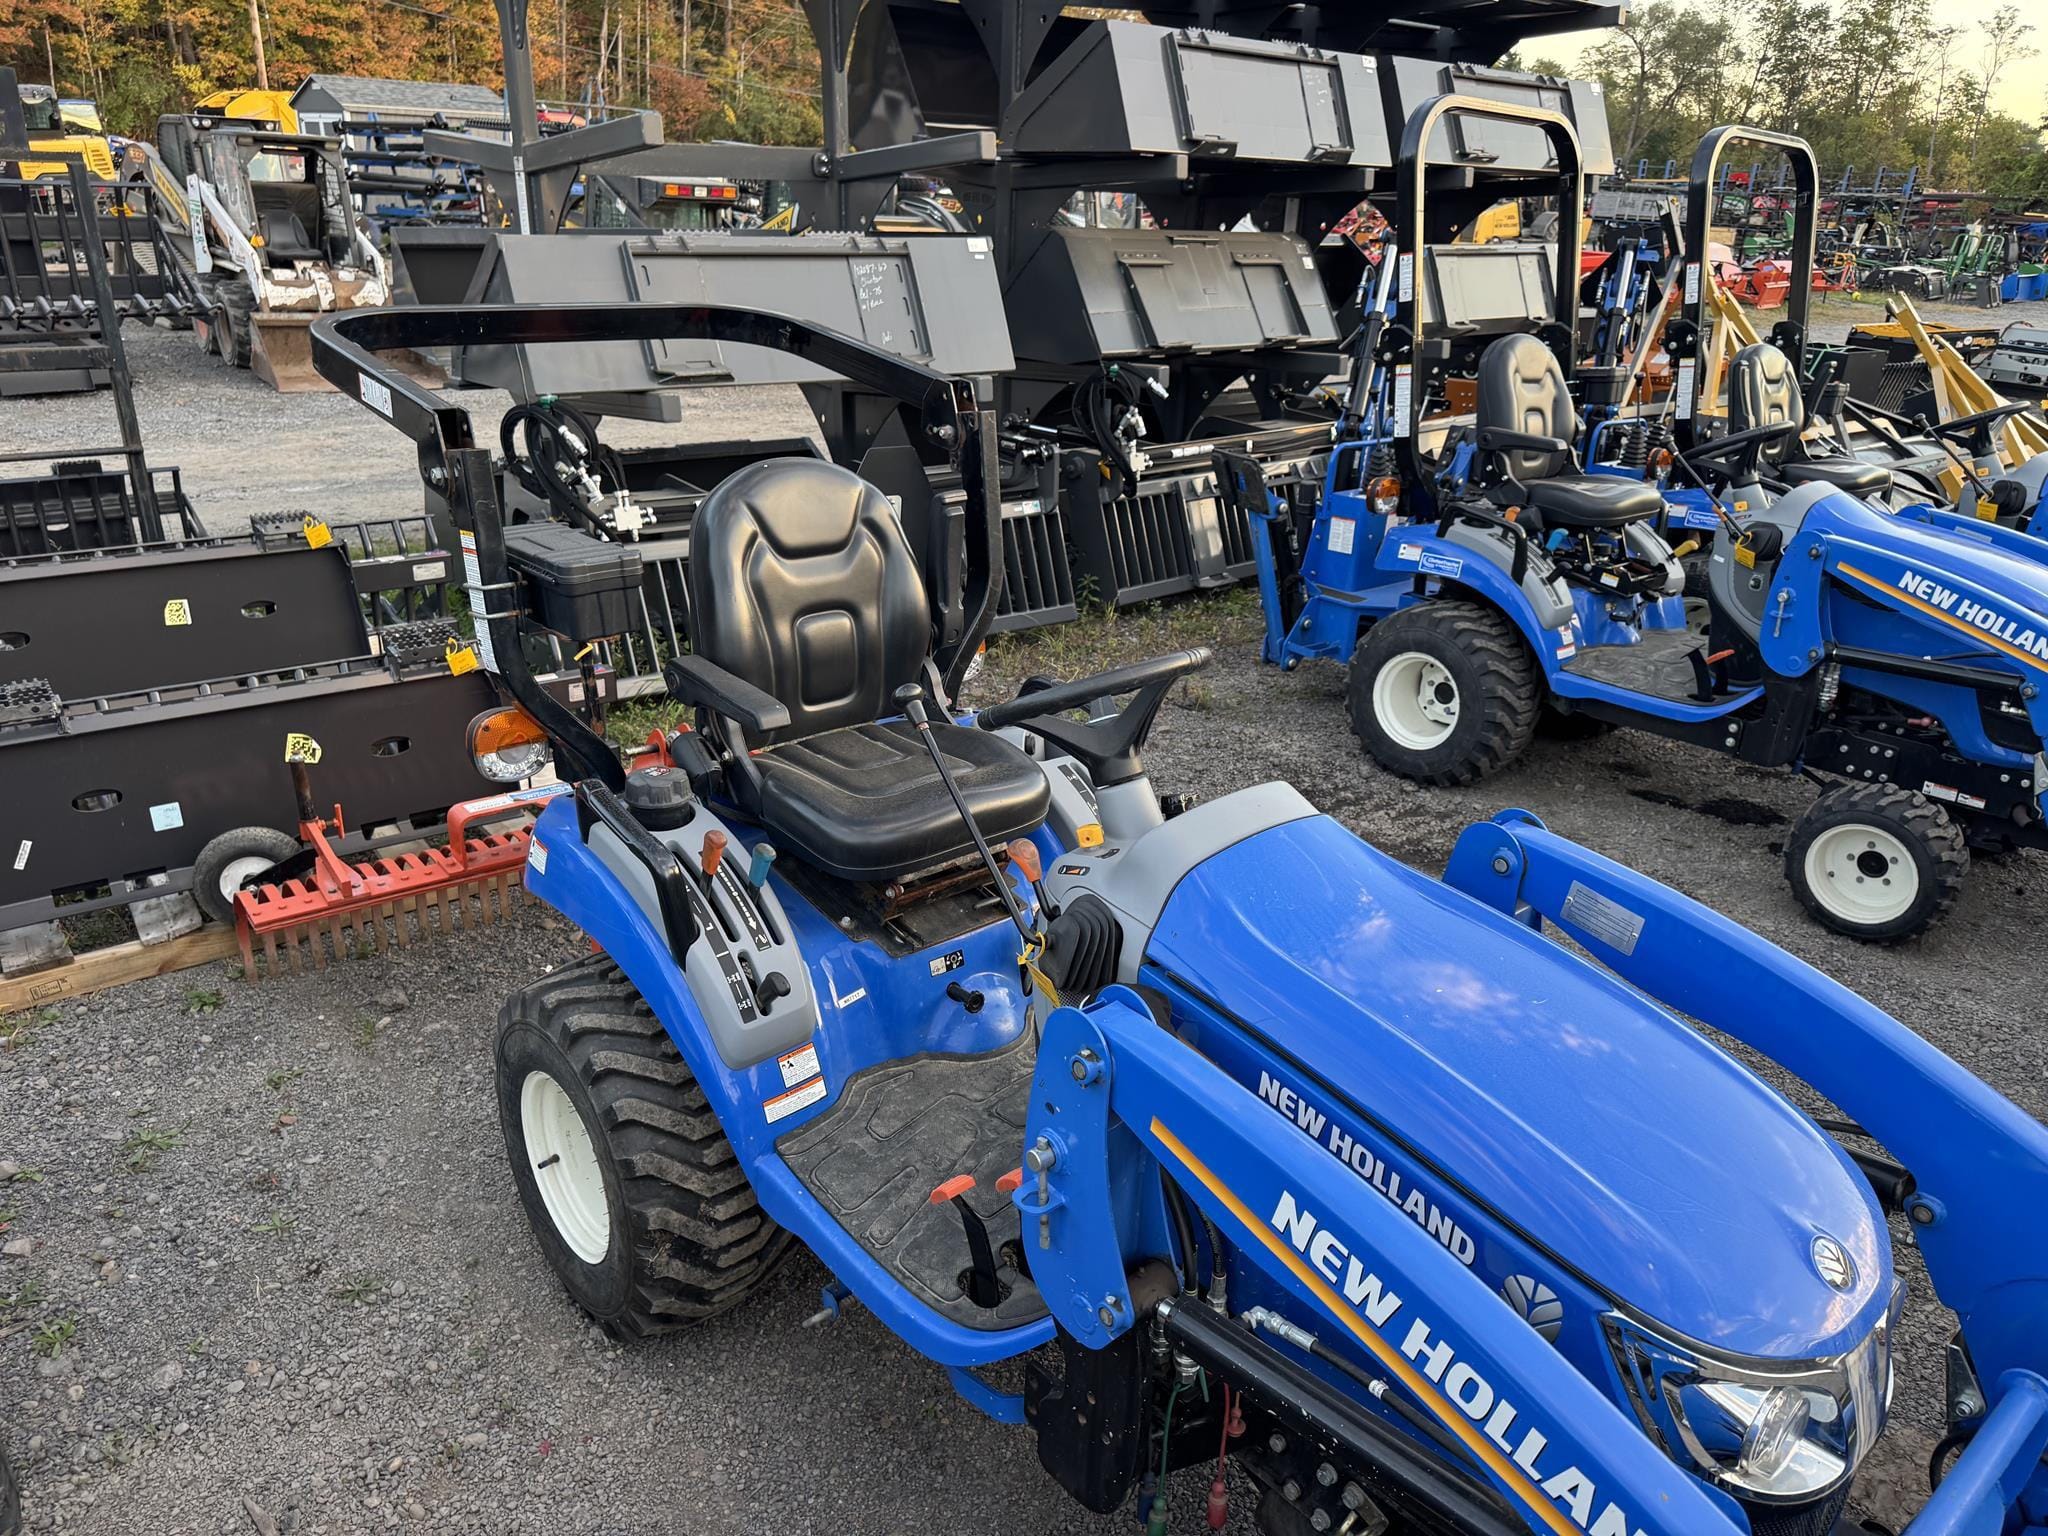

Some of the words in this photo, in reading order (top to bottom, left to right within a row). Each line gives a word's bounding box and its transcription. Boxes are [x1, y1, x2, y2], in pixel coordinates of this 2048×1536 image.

[1898, 570, 1959, 610] NEW
[1955, 598, 2048, 661] HOLLAN
[1258, 1070, 1326, 1139] NEW
[1328, 1124, 1475, 1265] HOLLAND
[1271, 1189, 1402, 1327] NEW
[1400, 1318, 1646, 1536] HOLLAN
